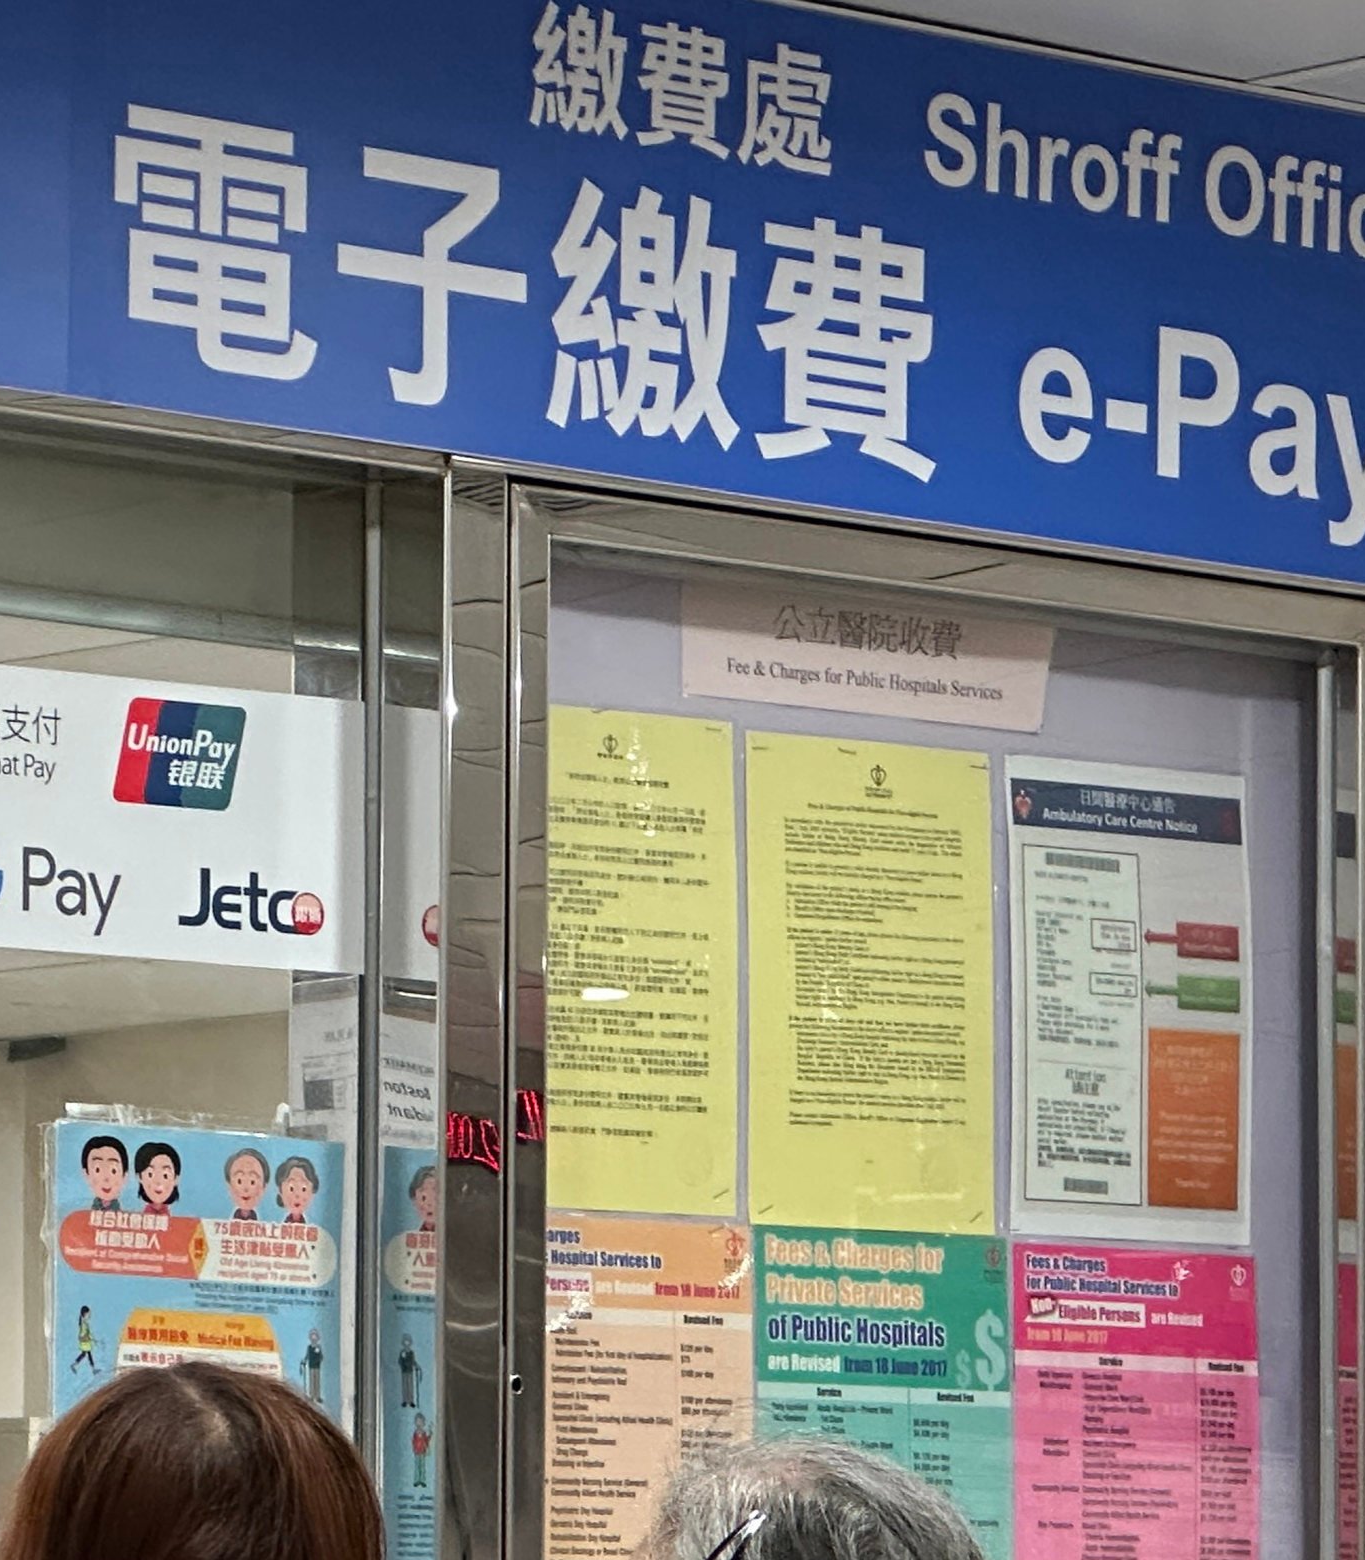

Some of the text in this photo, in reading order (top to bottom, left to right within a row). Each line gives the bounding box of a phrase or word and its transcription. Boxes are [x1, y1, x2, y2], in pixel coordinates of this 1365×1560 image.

[529, 1, 832, 177] 繳費處
[924, 91, 1184, 224] Shroff
[114, 103, 936, 482] 電子繳費
[774, 604, 963, 660] 公立醫院收費
[726, 656, 1003, 701] Fee & Charges for Public Hospitals Services
[23, 753, 58, 785] Pay
[127, 722, 237, 772] UnionPay
[167, 759, 224, 792] 银联
[1042, 807, 1198, 834] Ambulatory Care Centre Notice
[22, 846, 122, 936] Pay
[179, 867, 326, 937] Jetco
[765, 1232, 945, 1274] Fees & Charges for
[765, 1273, 924, 1310] Private Services
[767, 1314, 945, 1349] of Public Hospitals
